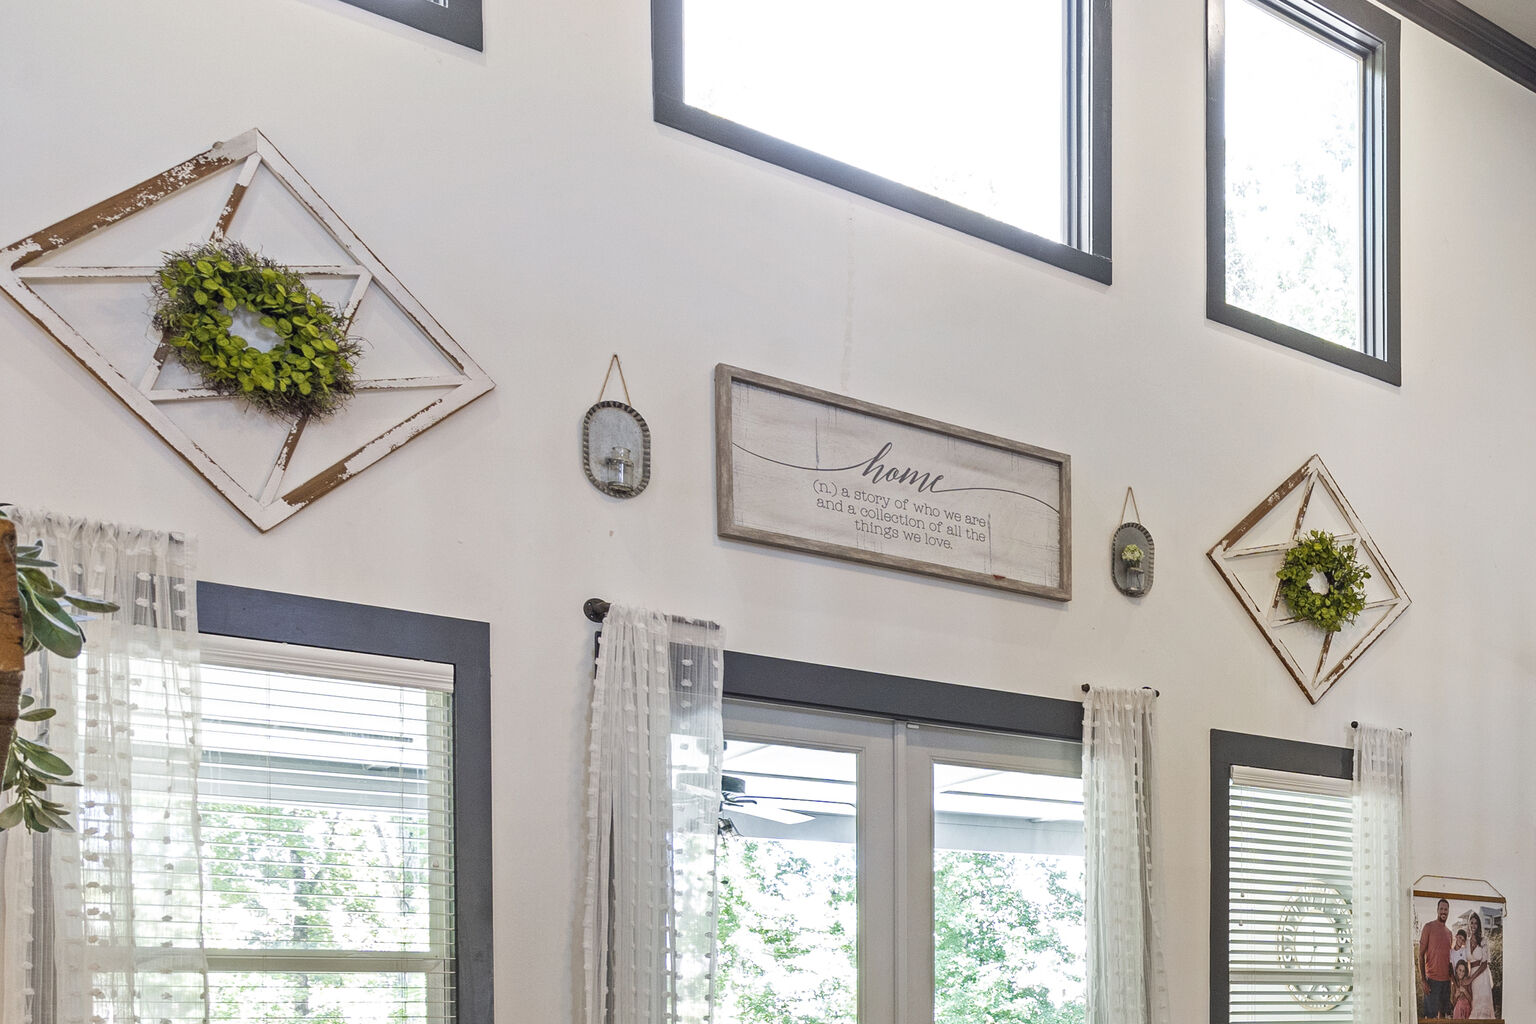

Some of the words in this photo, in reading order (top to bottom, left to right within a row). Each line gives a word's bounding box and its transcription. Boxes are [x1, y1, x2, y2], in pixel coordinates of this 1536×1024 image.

[862, 441, 945, 493] home
[812, 479, 838, 497] (n.)
[841, 487, 850, 498] a
[854, 489, 891, 509] story
[894, 499, 909, 511] of
[913, 502, 940, 518] who
[944, 509, 962, 522] we
[965, 514, 986, 528] are
[816, 497, 843, 513] and
[847, 503, 856, 515] a
[860, 507, 925, 530] collection
[929, 520, 943, 532] of
[947, 523, 962, 538] all
[966, 528, 986, 542] the
[855, 519, 899, 540] things
[903, 530, 921, 543] we
[925, 533, 953, 550] love.
